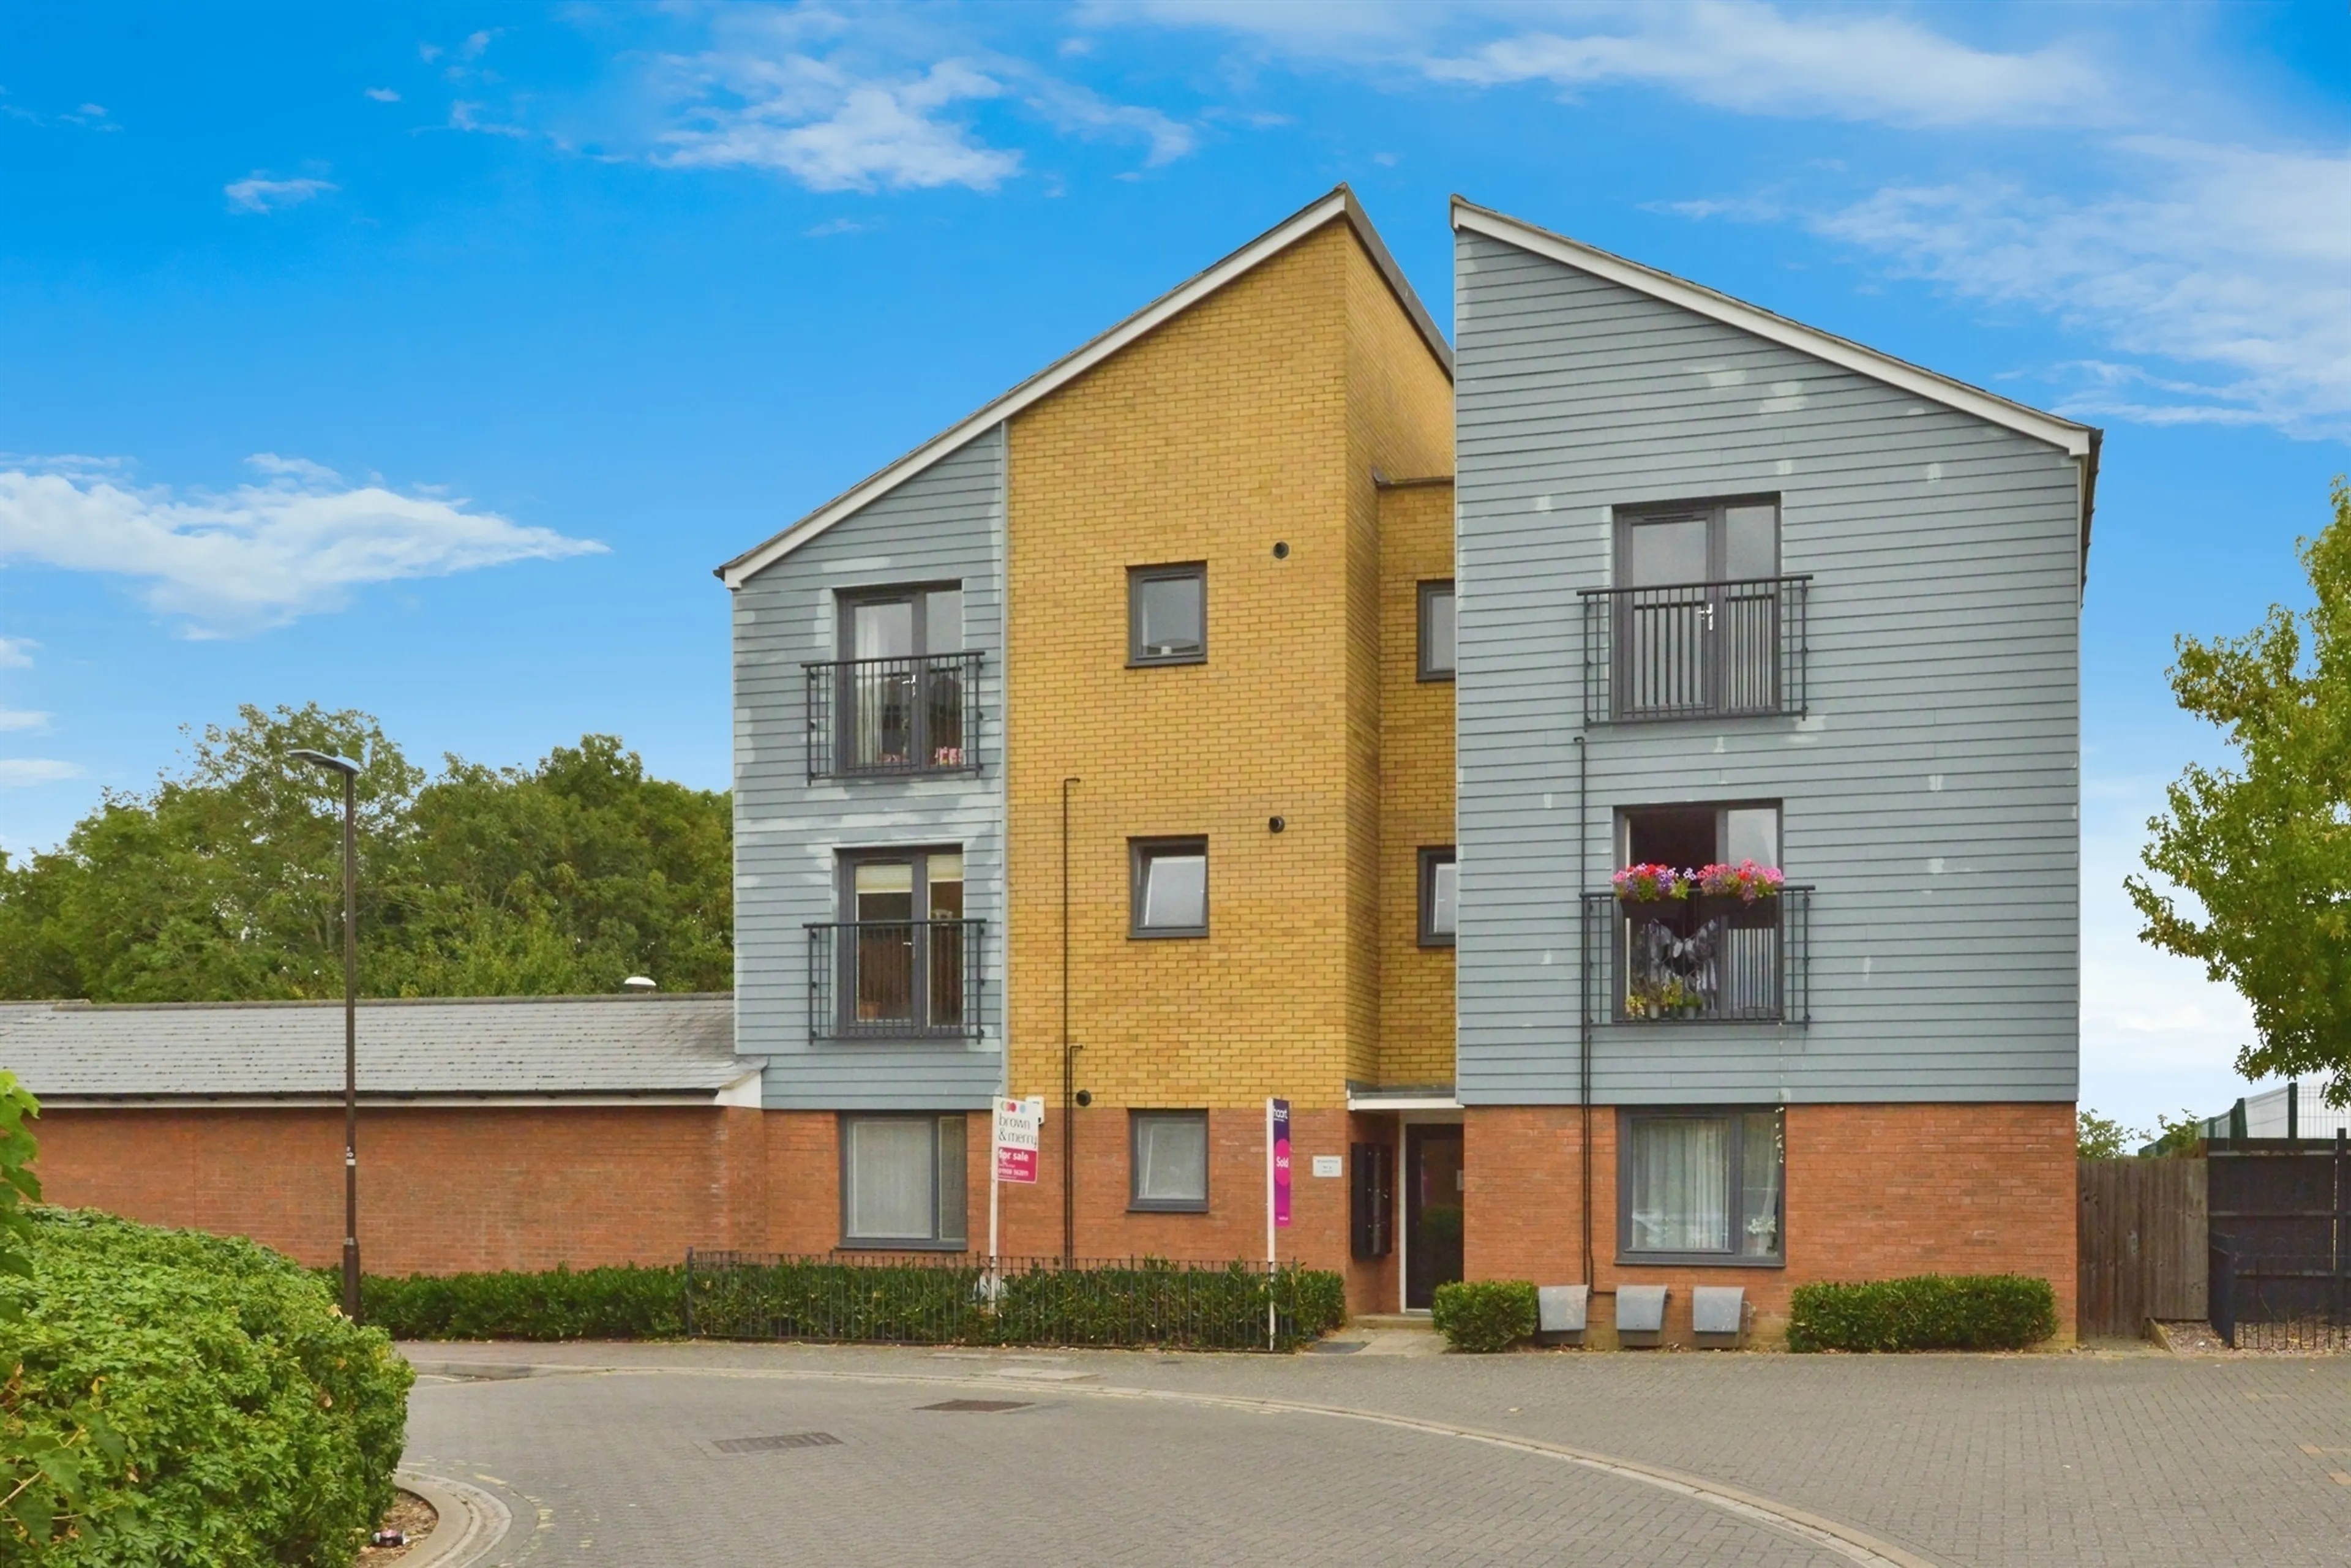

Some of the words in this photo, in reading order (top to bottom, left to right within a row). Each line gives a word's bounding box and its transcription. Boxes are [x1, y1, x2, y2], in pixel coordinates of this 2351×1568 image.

[999, 1112, 1030, 1130] brown
[1008, 1132, 1037, 1149] merry
[999, 1148, 1011, 1160] for
[1013, 1151, 1029, 1161] sale
[1276, 1155, 1289, 1168] Sold
